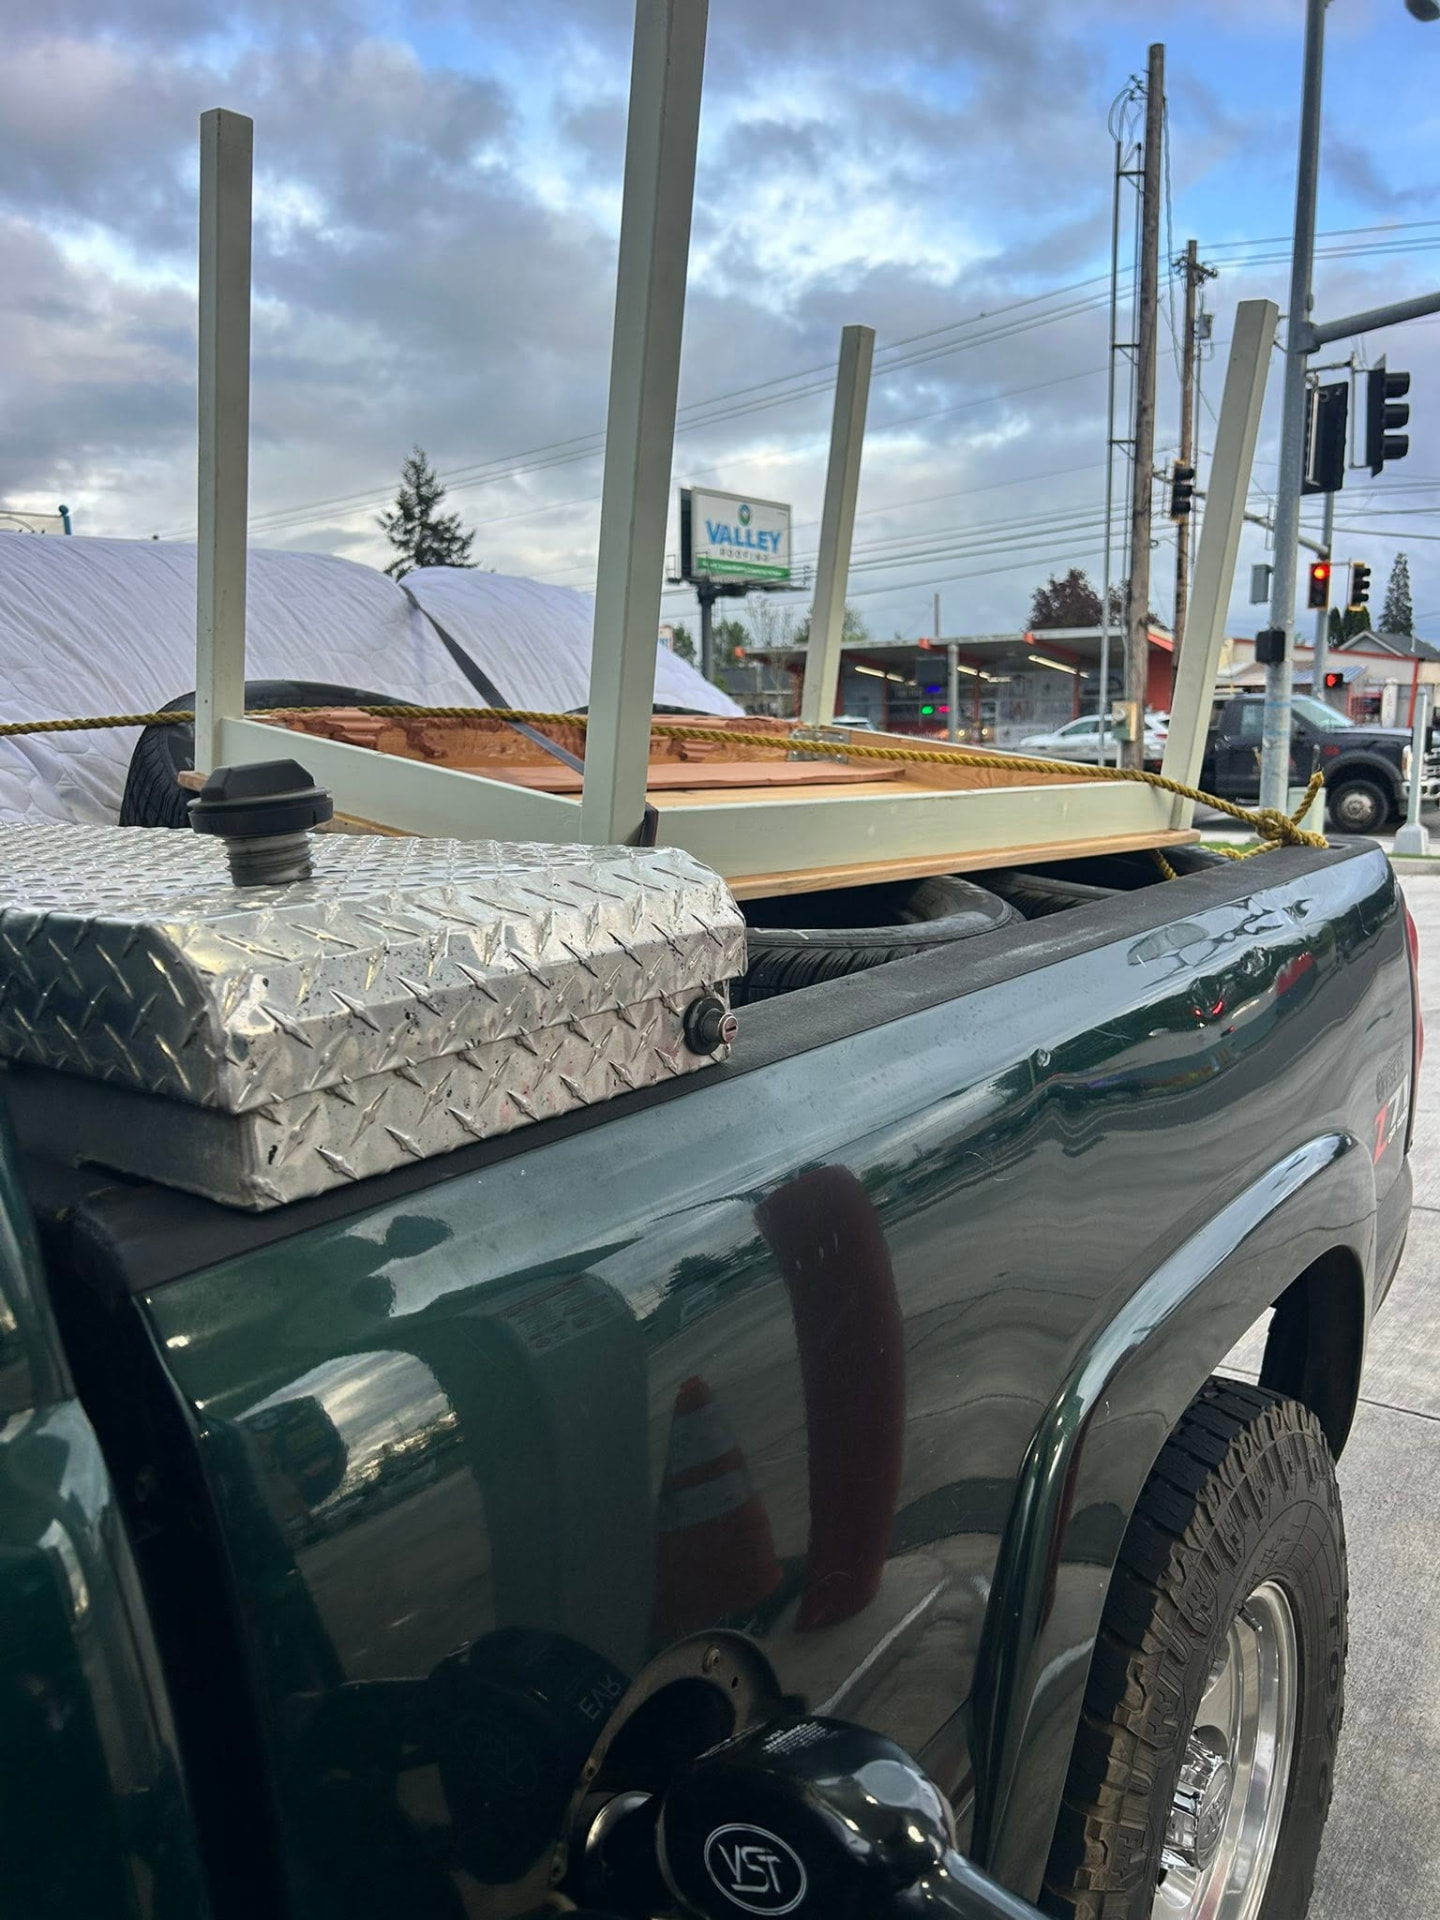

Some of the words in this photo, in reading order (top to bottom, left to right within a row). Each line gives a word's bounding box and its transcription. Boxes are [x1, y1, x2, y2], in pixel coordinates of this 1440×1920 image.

[705, 520, 781, 553] VALLEY
[1317, 1604, 1340, 1811] TOYO
[718, 1843, 782, 1895] VST
